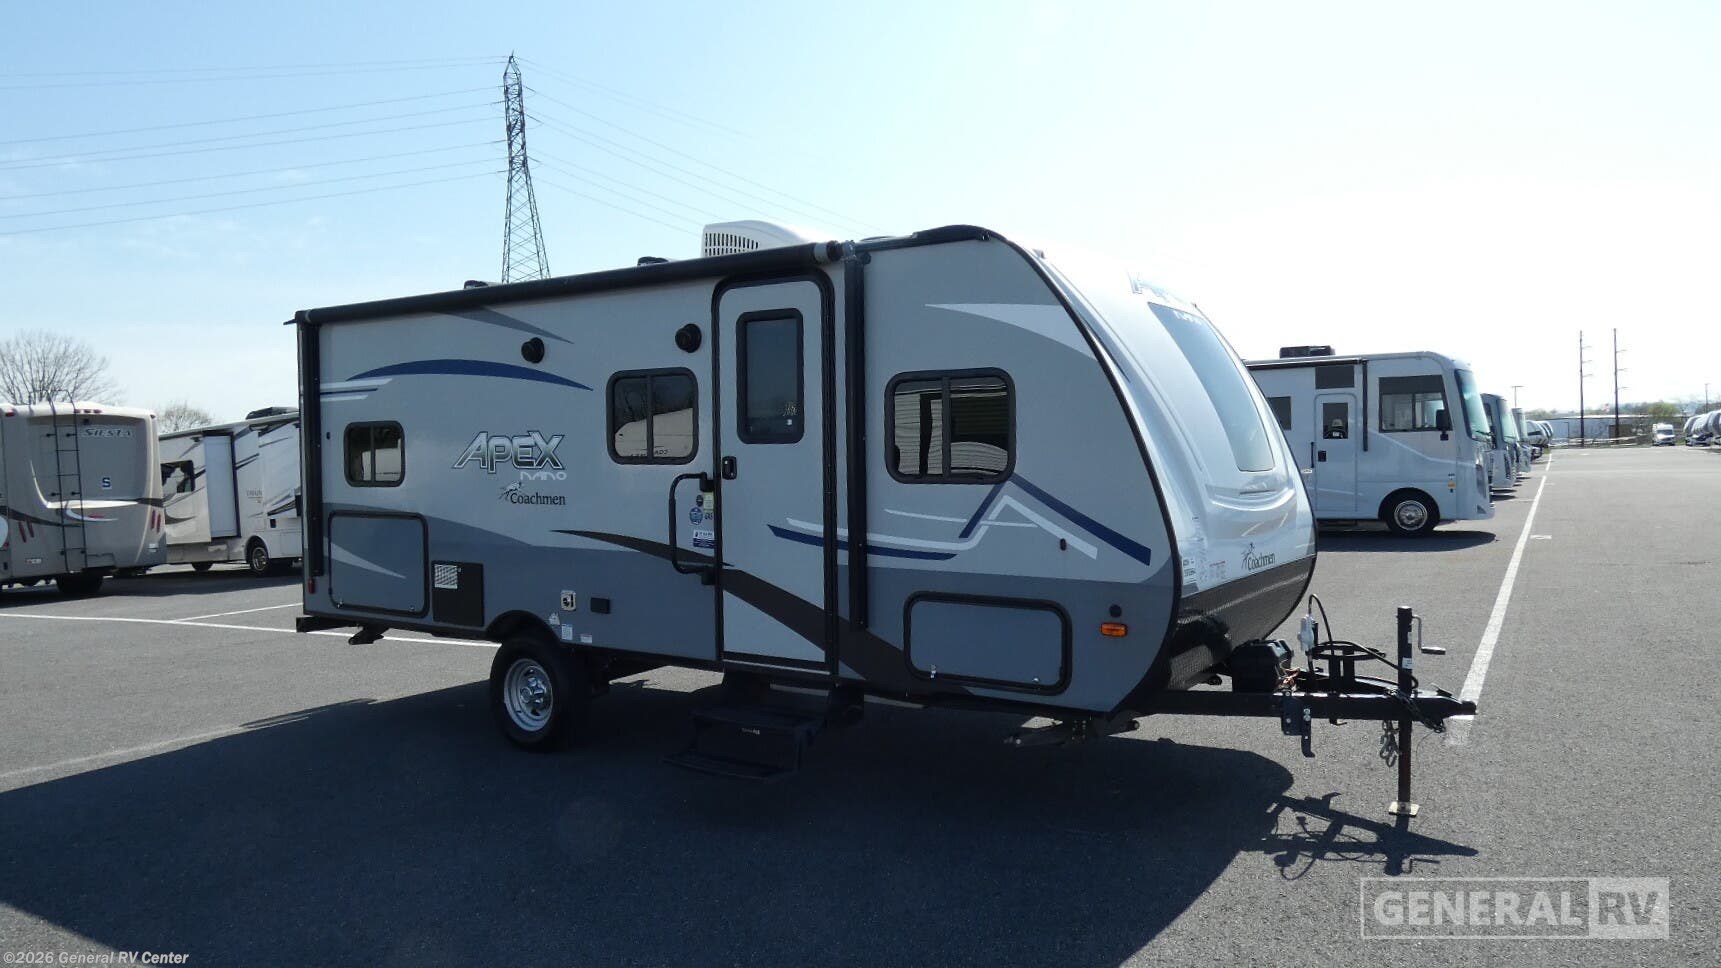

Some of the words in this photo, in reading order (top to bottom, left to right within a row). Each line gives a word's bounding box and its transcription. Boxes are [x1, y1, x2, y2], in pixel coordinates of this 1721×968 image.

[84, 428, 132, 438] SIESTA
[451, 430, 565, 474] APEX
[102, 477, 111, 488] S
[510, 491, 566, 506] Coachmen
[1247, 552, 1275, 571] Coachmen
